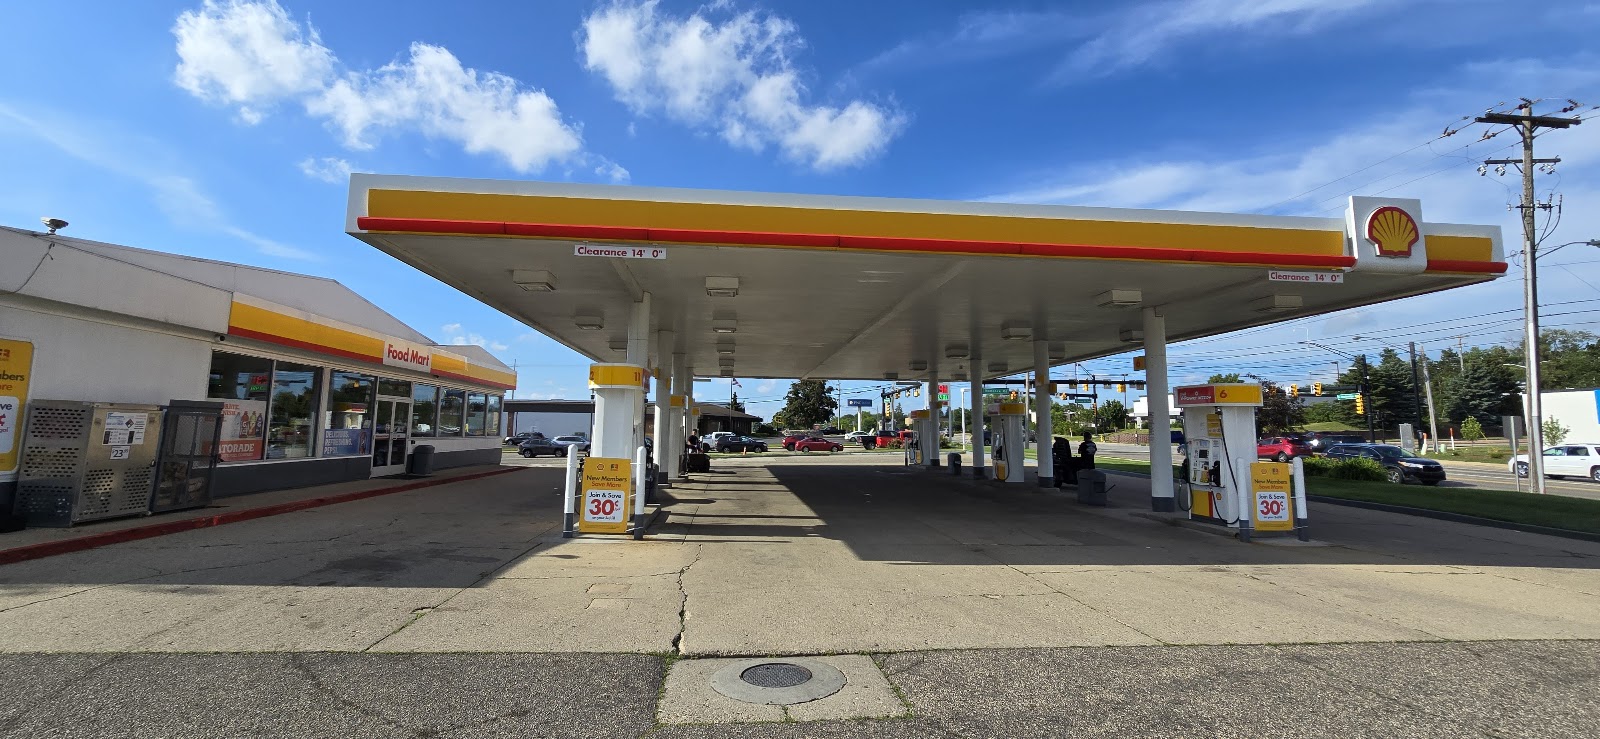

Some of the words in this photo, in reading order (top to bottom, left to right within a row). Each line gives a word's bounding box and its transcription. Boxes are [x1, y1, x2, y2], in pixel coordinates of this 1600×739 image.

[577, 246, 627, 257] Clearance
[632, 249, 646, 257] 14'
[1270, 271, 1310, 281] Clearance
[1314, 273, 1327, 281] 14'
[387, 343, 410, 362] Food
[410, 349, 430, 366] Mart
[634, 371, 641, 381] 11
[1219, 389, 1228, 399] 6
[586, 474, 600, 482] New
[591, 480, 606, 488] Save
